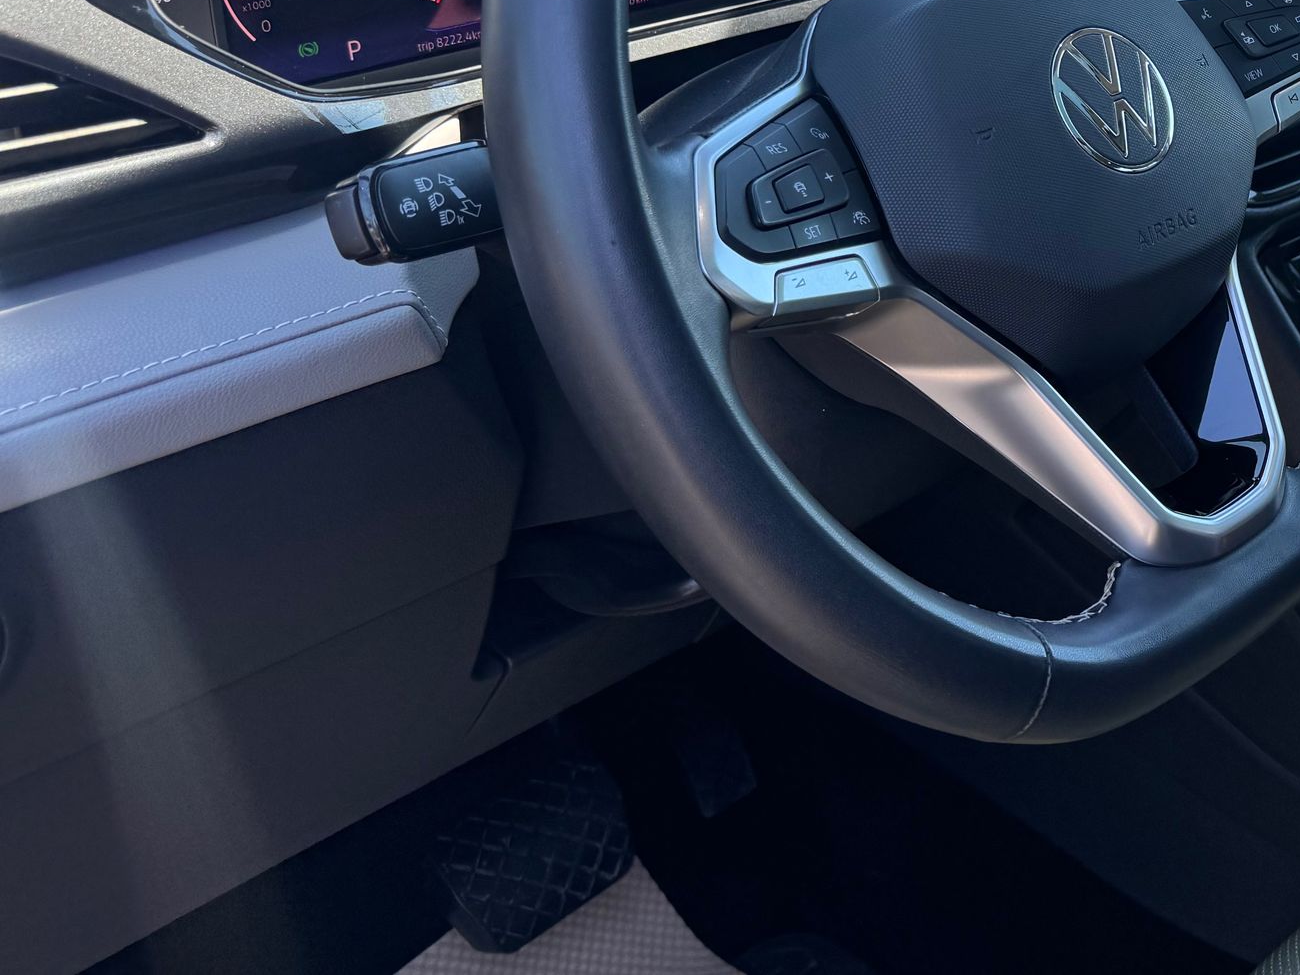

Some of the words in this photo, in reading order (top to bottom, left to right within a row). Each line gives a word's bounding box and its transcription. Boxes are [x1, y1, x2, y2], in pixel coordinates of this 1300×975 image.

[242, 0, 272, 13] x1000
[261, 20, 272, 33] 0
[1269, 23, 1282, 34] OK
[346, 40, 362, 62] P
[417, 41, 434, 53] trip
[1244, 67, 1265, 83] VIEW
[765, 142, 788, 155] RES
[804, 224, 822, 240] SET
[1137, 208, 1198, 249] AIRBAG
